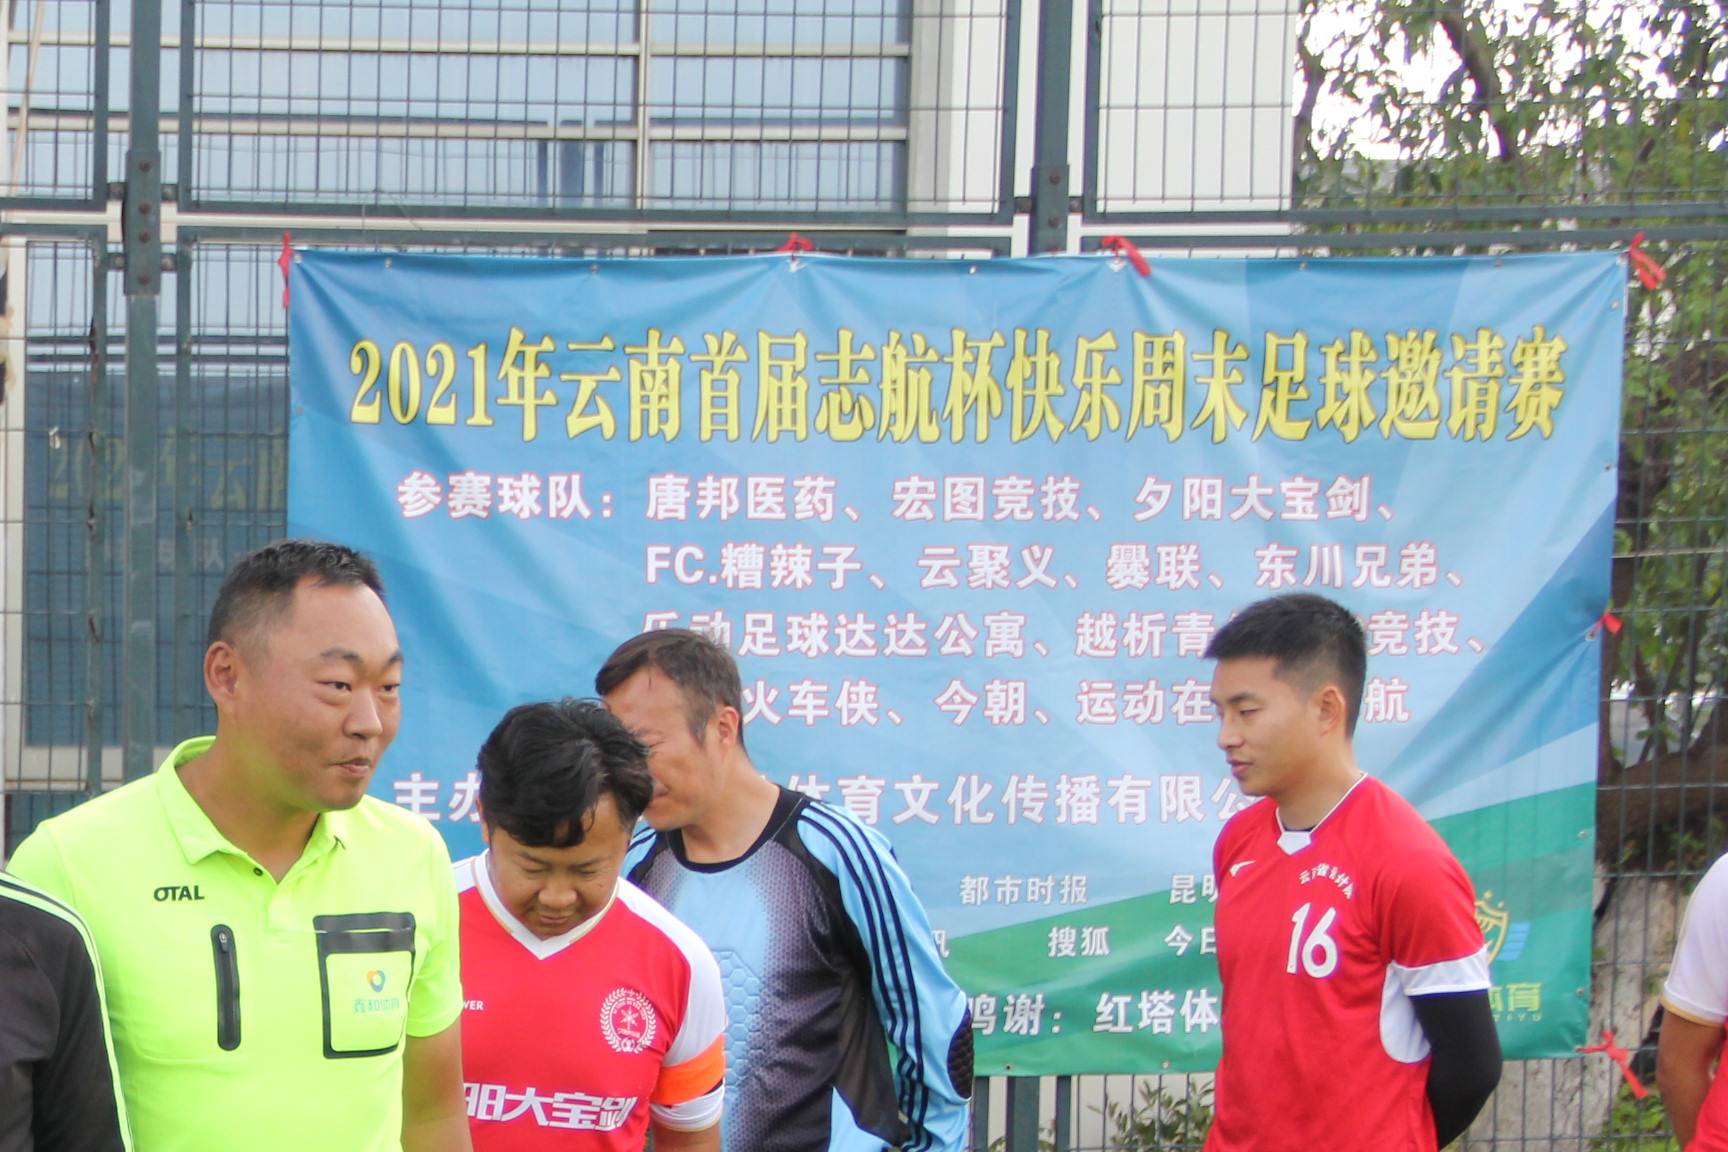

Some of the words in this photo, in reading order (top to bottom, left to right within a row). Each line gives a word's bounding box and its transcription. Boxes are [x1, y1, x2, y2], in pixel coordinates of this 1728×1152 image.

[349, 324, 1569, 443] 2021年云南首届志航杯快乐周末足球邀请赛
[960, 874, 1088, 905] 都市时报
[1048, 926, 1110, 958] 搜狐
[1286, 902, 1338, 978] 16
